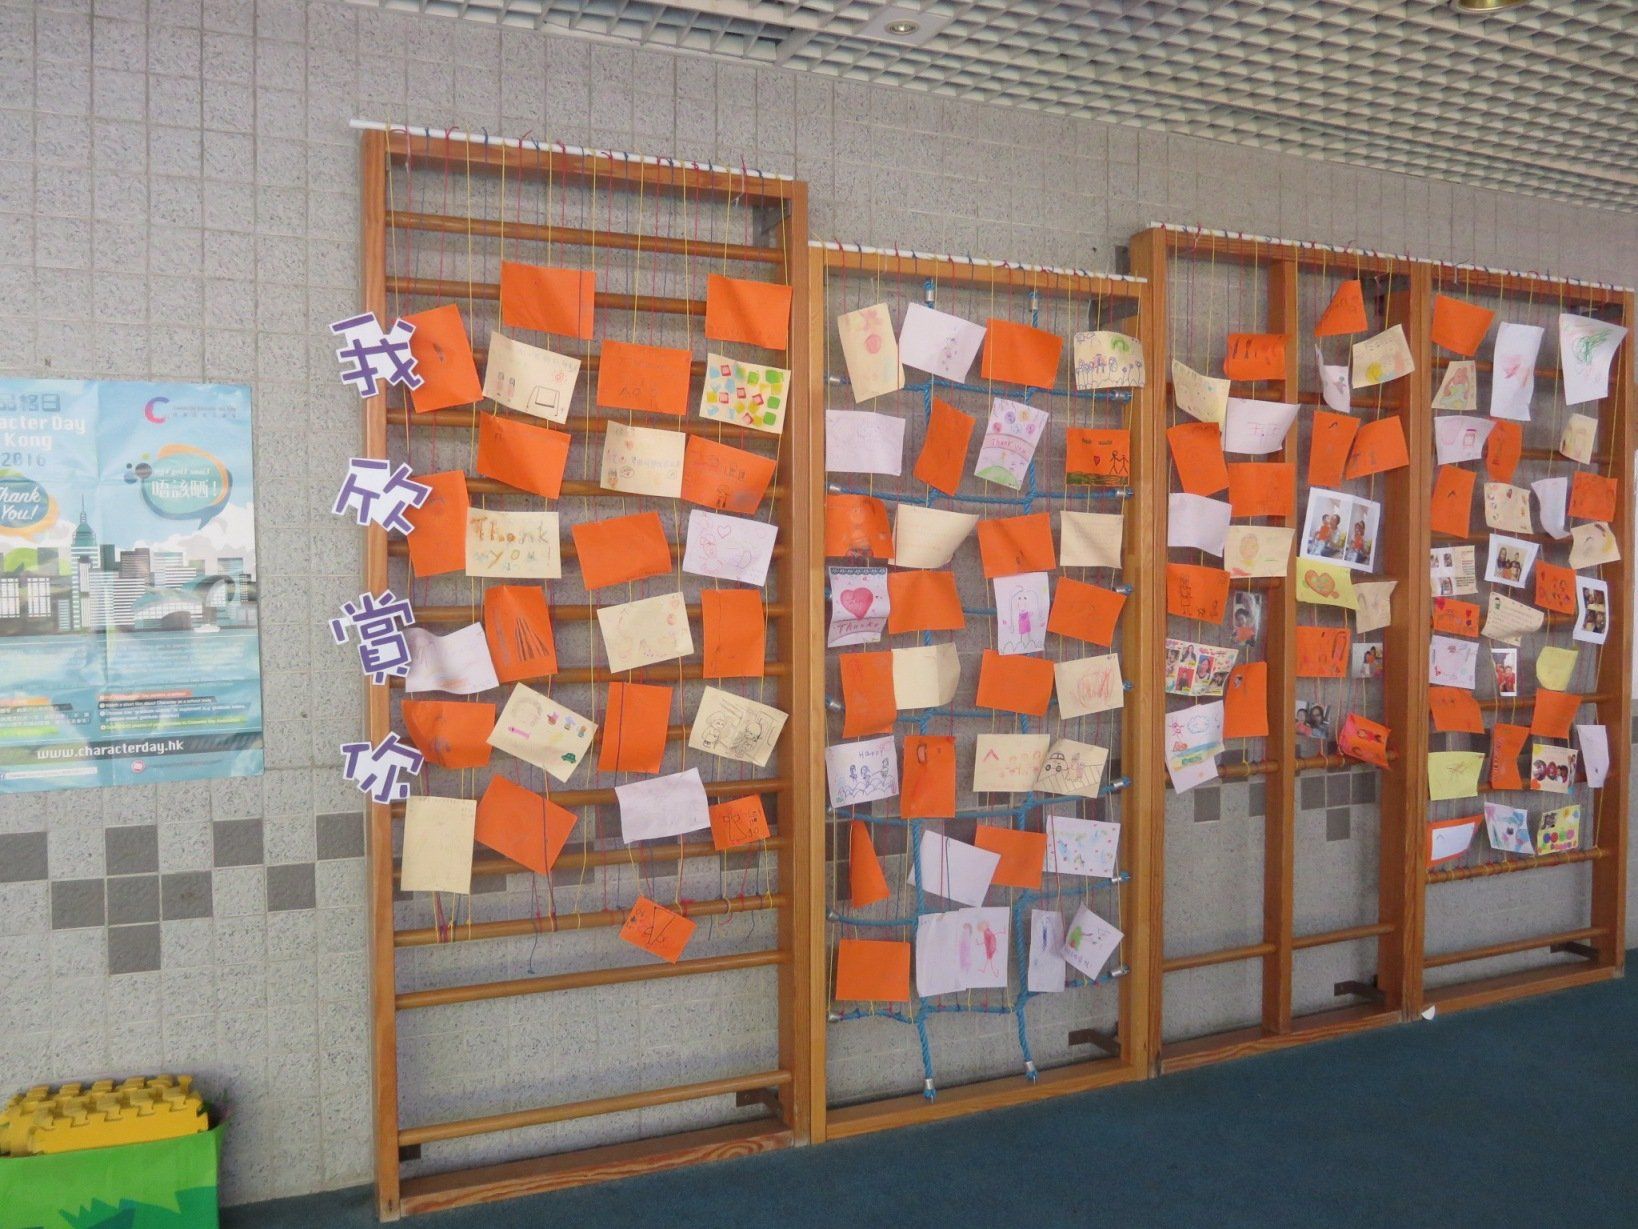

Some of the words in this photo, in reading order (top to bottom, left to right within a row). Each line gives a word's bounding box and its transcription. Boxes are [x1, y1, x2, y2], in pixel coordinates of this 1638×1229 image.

[52, 415, 86, 435] Day
[4, 432, 53, 451] Kong
[1, 504, 39, 520] You!
[37, 740, 184, 759] www.characterday.hk
